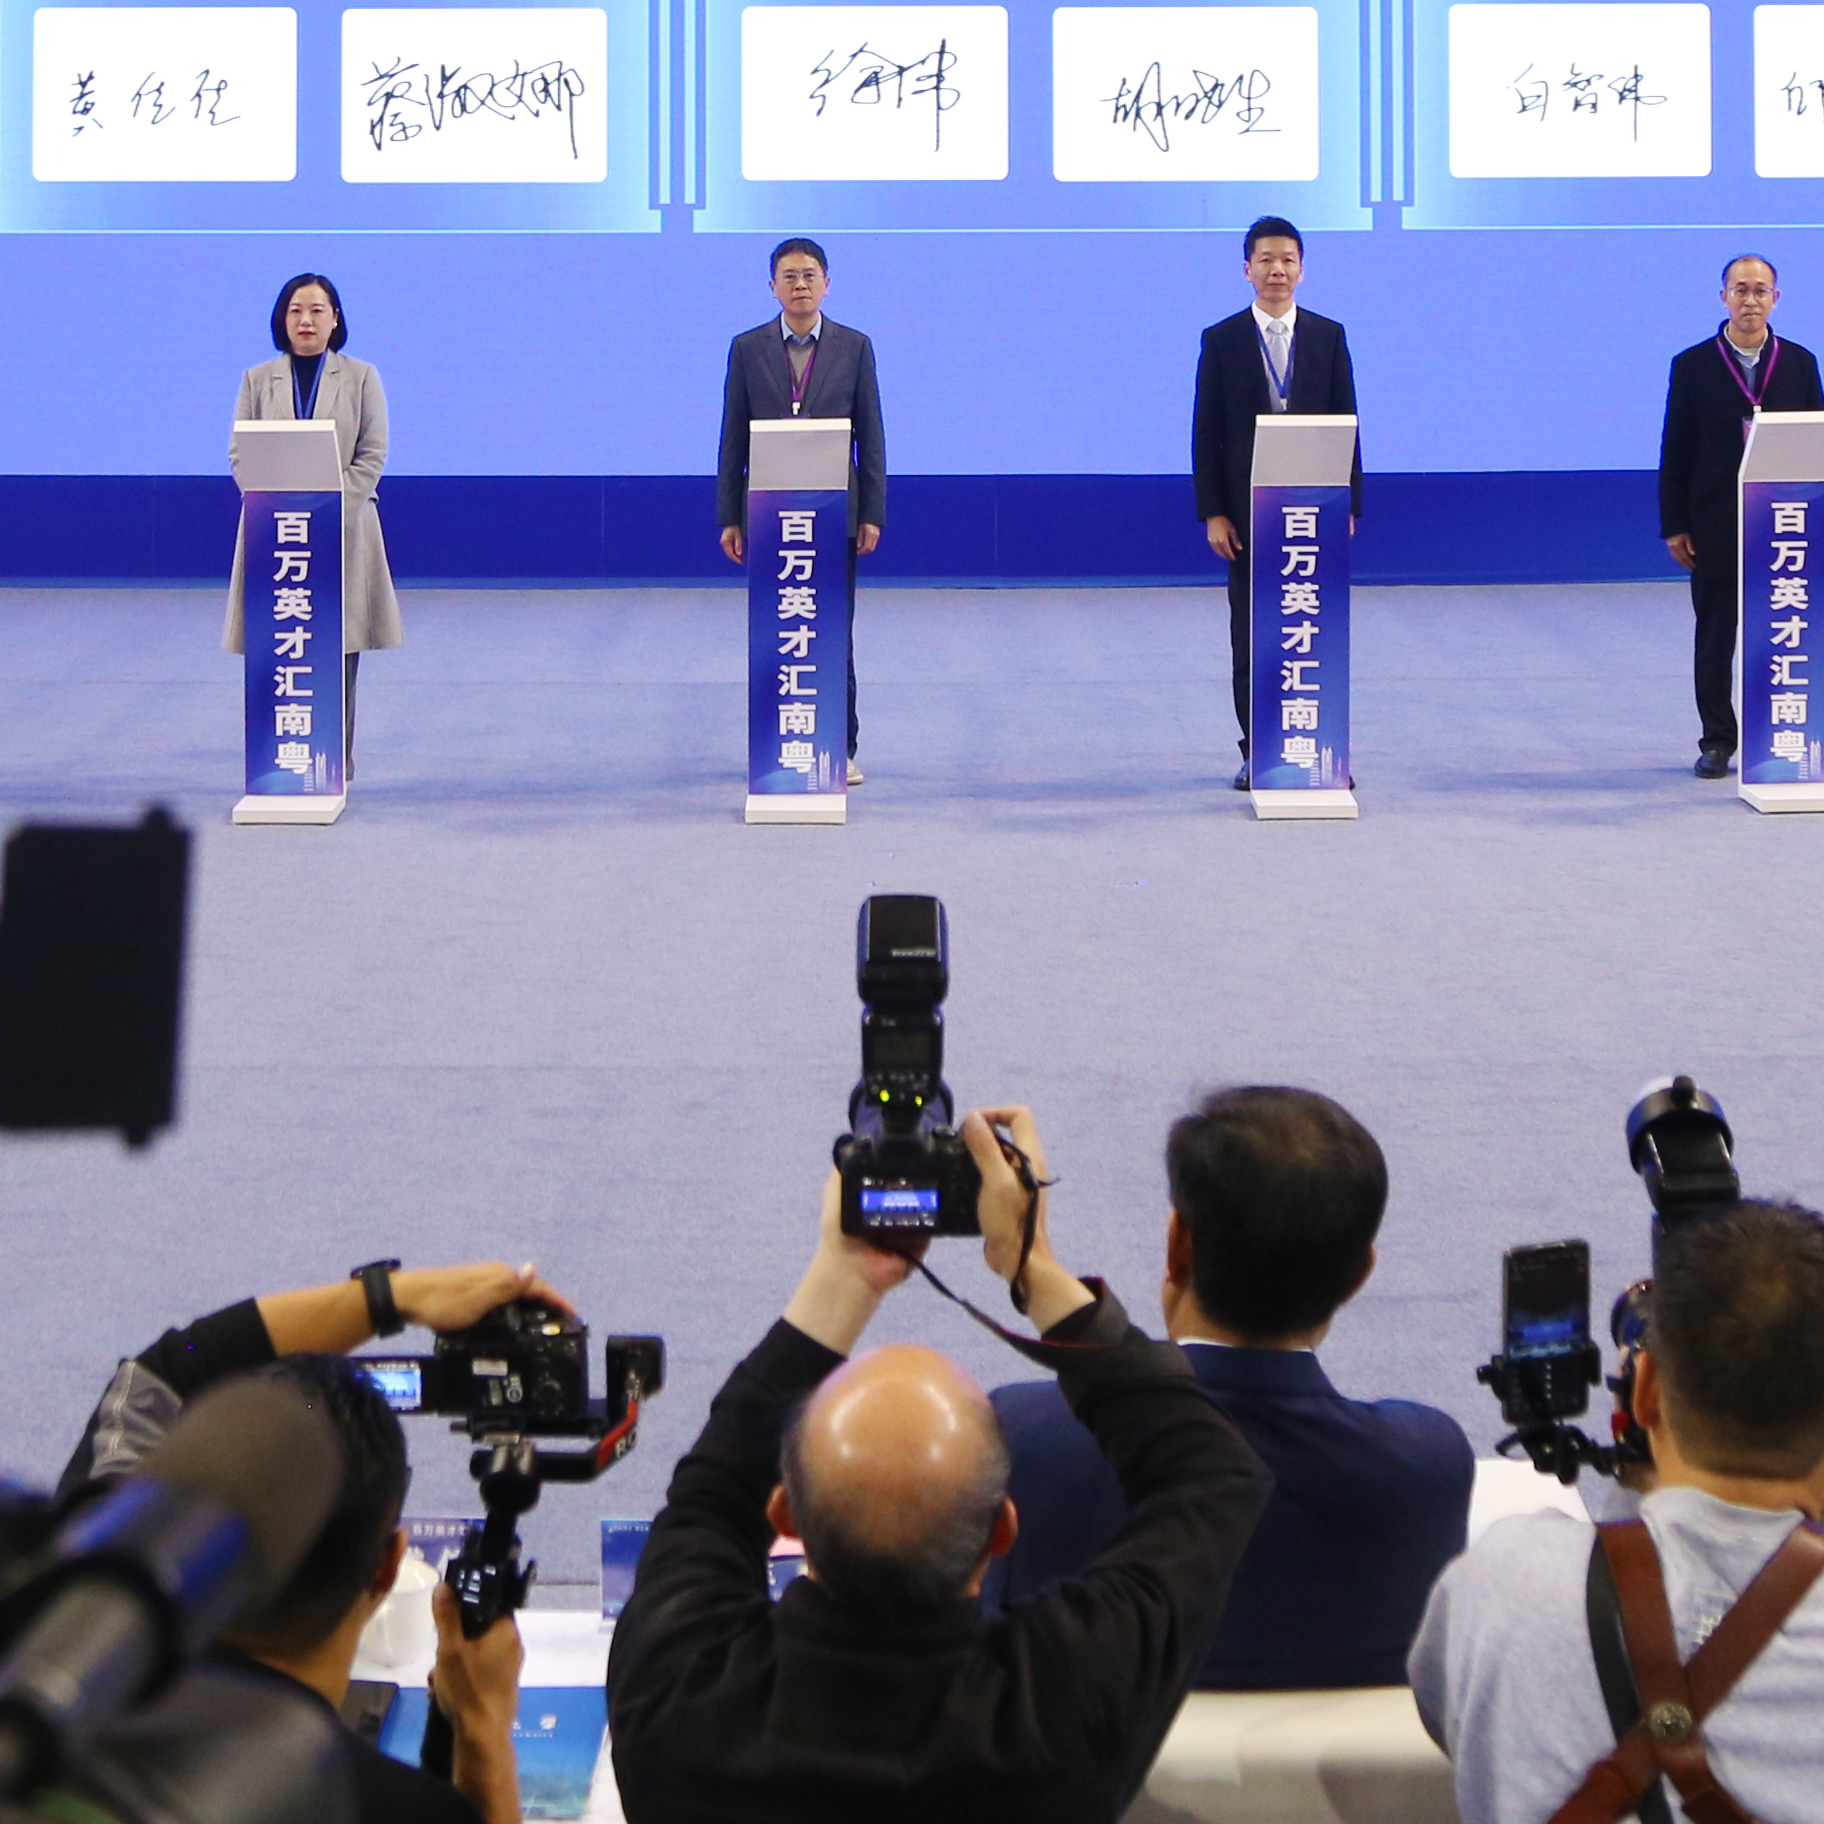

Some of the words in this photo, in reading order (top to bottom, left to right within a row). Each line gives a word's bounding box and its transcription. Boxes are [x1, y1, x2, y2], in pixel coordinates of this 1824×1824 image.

[272, 511, 315, 776] 百万英才汇南粤
[777, 510, 818, 774] 百万英才汇南粤
[1279, 505, 1321, 770] 百万英才汇南粤
[1769, 502, 1810, 764] 百万英才汇南粤
